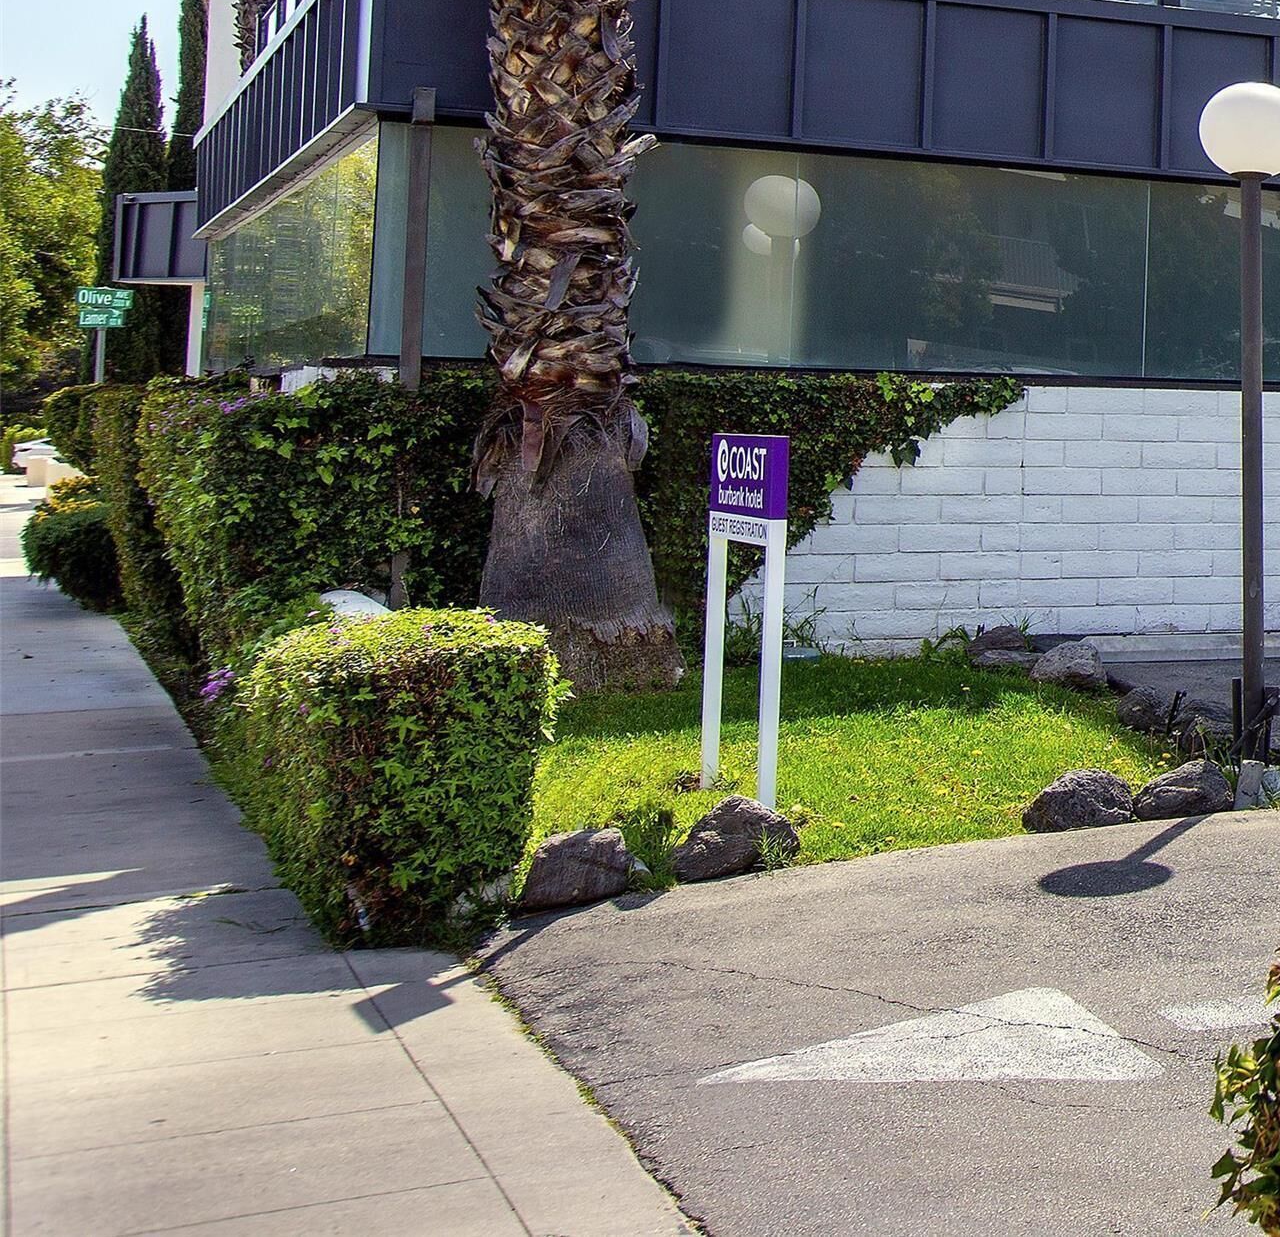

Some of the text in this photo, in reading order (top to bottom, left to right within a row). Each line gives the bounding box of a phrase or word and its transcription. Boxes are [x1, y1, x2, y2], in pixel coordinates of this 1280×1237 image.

[78, 289, 113, 305] Olive
[729, 446, 767, 480] COAST
[718, 484, 763, 509] burbank hotel
[711, 517, 768, 539] GUEST REGISTRATION
